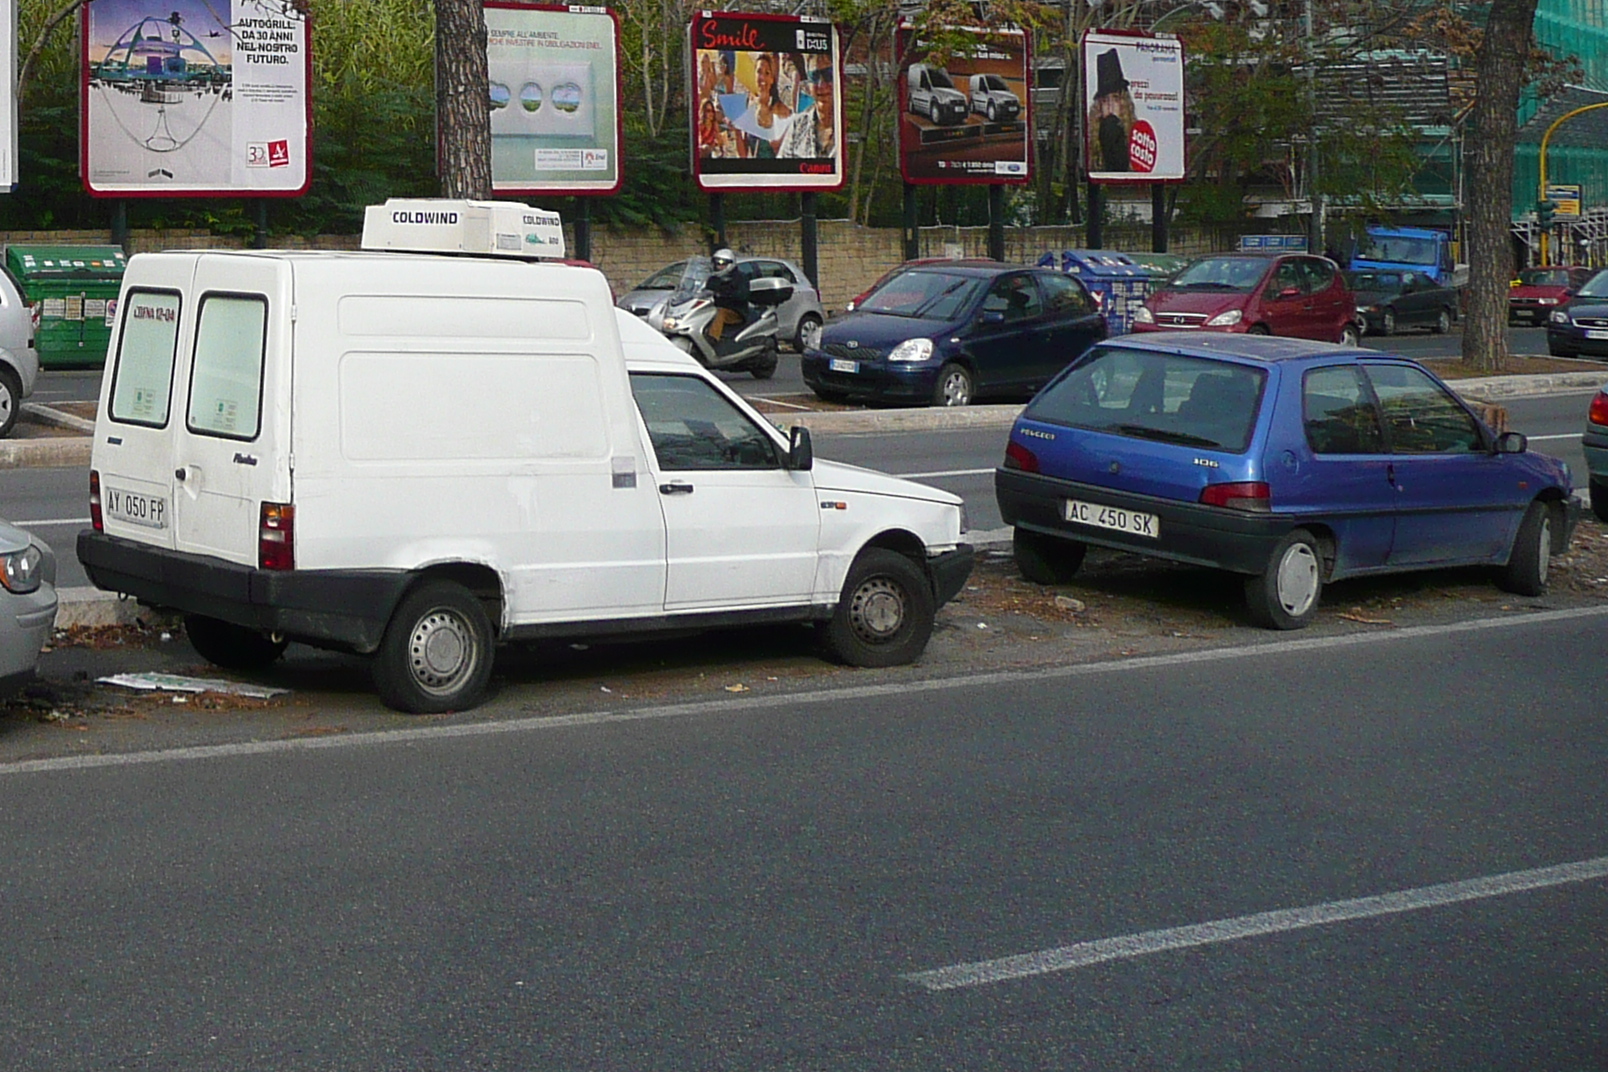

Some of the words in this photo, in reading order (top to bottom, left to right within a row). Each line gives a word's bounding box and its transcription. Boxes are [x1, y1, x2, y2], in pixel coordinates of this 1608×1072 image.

[242, 30, 255, 40] DA
[256, 30, 268, 40] 30
[269, 31, 294, 41] ANNI
[702, 19, 765, 50] Smile
[236, 42, 257, 52] NEL
[258, 42, 298, 53] NOSTRO
[246, 54, 290, 65] FUTURO.
[1132, 129, 1156, 152] sotto
[1130, 143, 1154, 165] costo
[392, 211, 458, 224] COLDWIND
[522, 215, 560, 227] COLDWIND
[1020, 428, 1056, 441] PEUGEOT
[1193, 457, 1220, 468] 106
[108, 490, 120, 513] AY
[125, 495, 147, 518] 050
[150, 500, 164, 522] FP
[1070, 503, 1089, 521] AC
[1098, 508, 1127, 529] 450
[1133, 514, 1152, 535] SK
